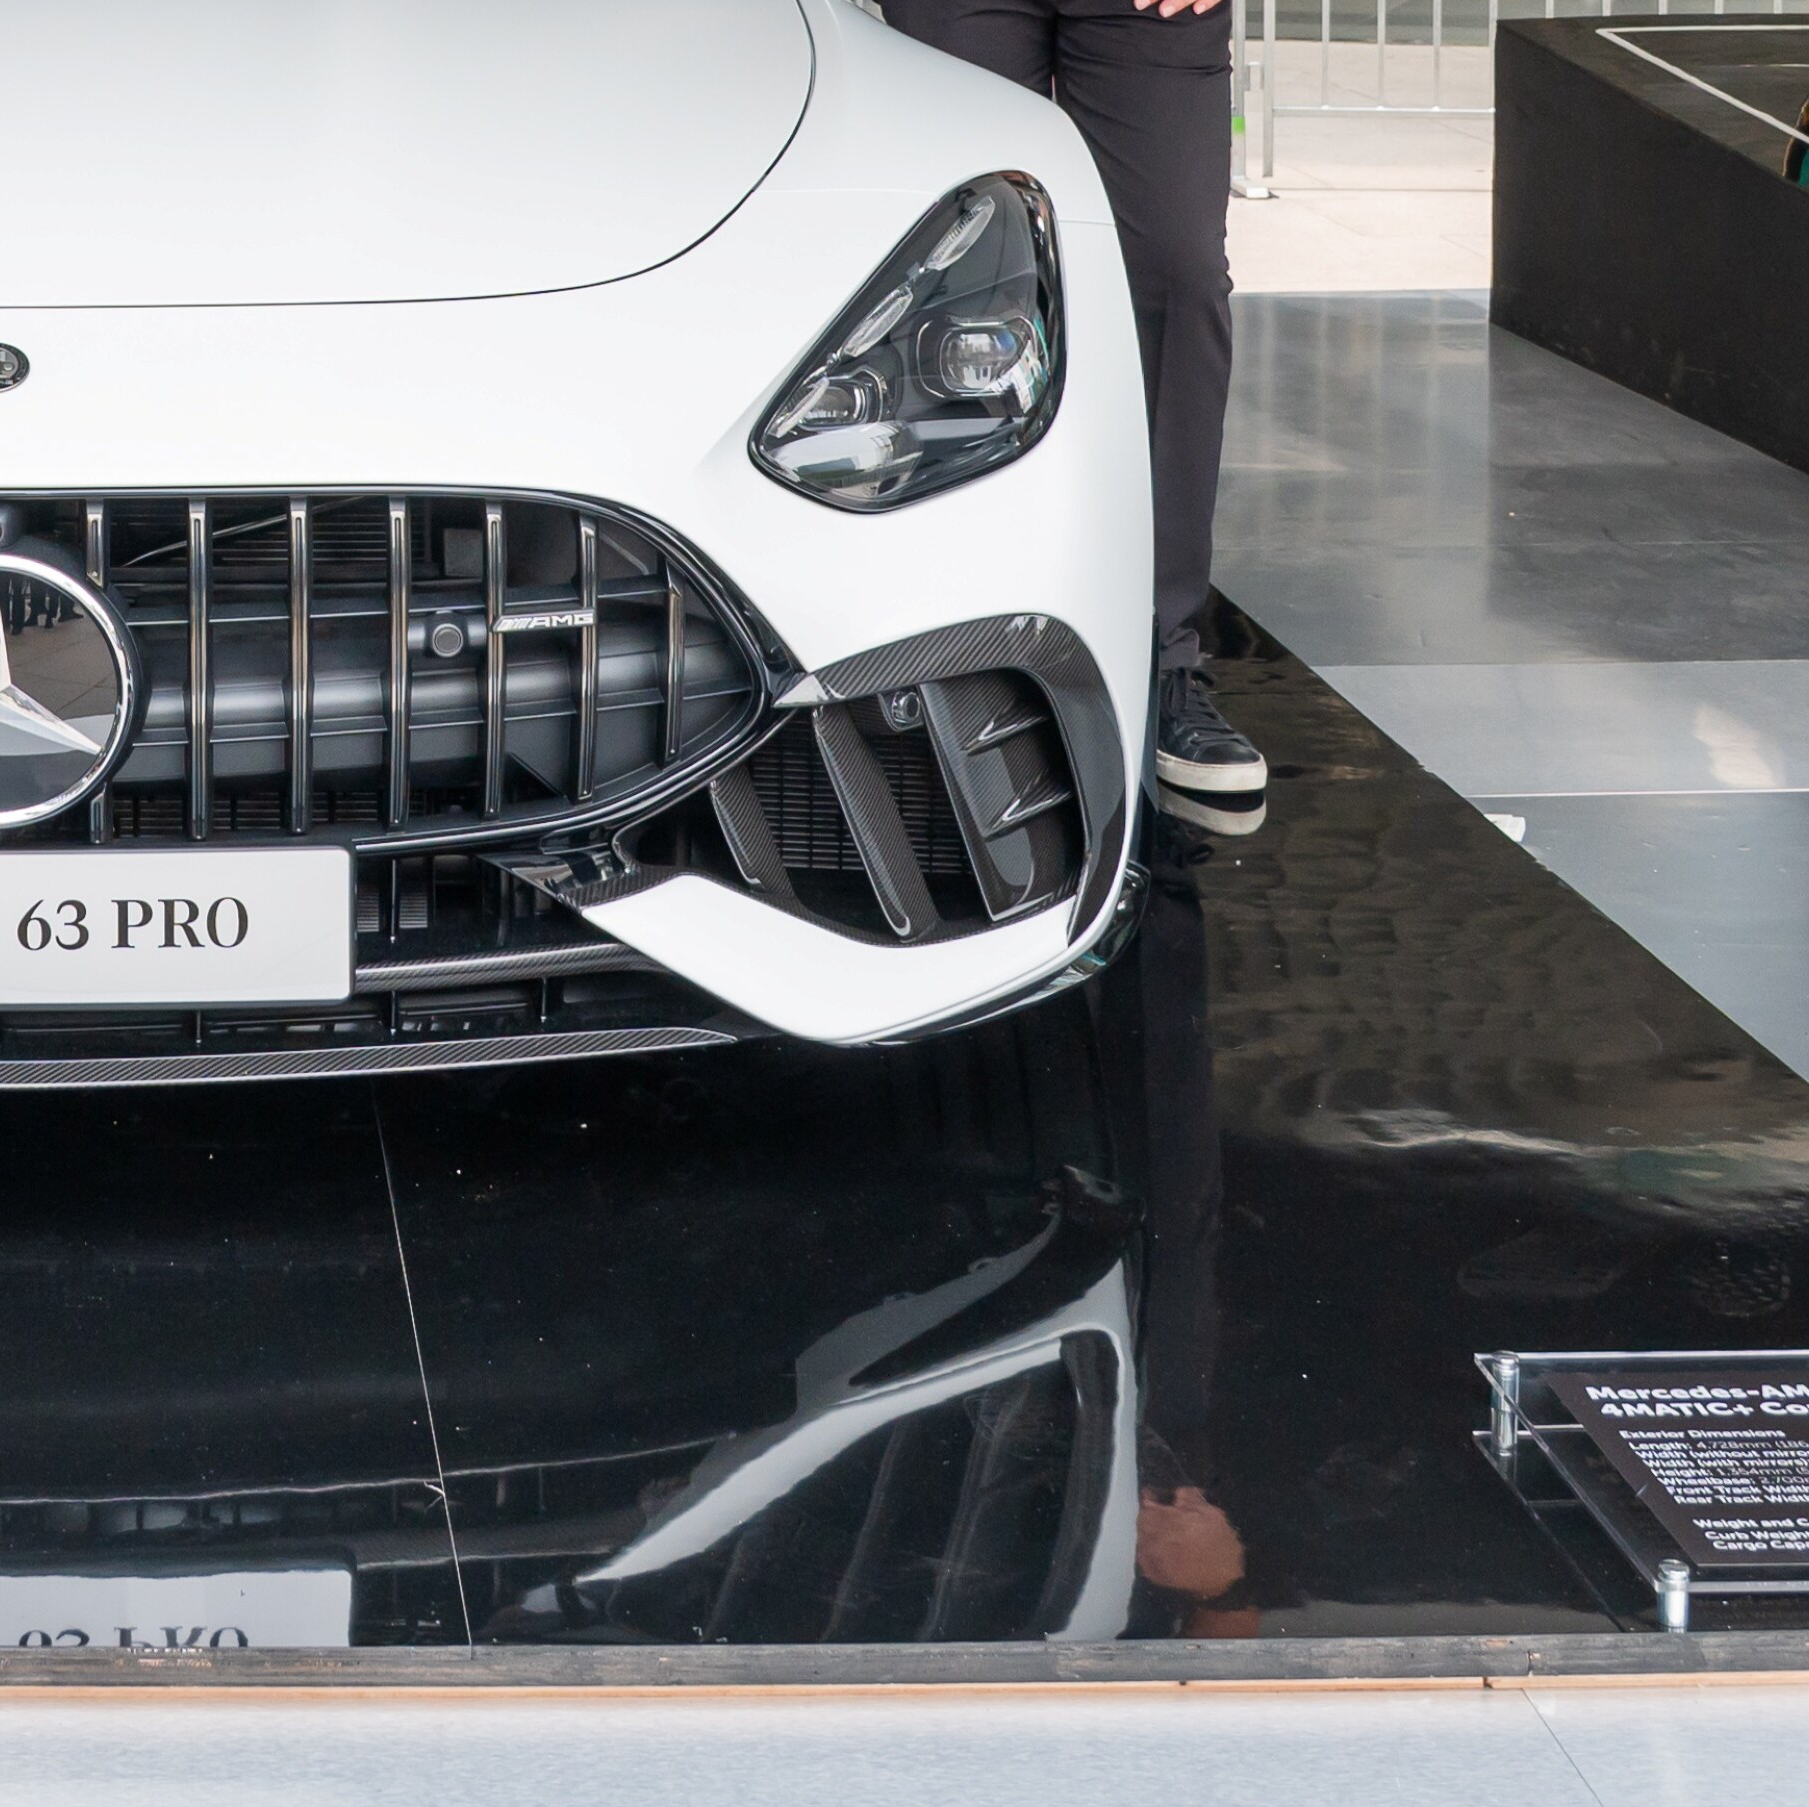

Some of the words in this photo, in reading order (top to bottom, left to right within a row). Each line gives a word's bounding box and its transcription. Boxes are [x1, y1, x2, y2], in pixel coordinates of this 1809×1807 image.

[528, 612, 594, 629] AMG
[16, 899, 90, 950] 63
[111, 897, 250, 948] PRO
[1601, 1402, 1754, 1417] 4MATIC+
[1759, 1401, 1809, 1415] Co
[1618, 1430, 1685, 1439] Exterior
[1687, 1429, 1786, 1438] Dimensions
[1635, 1450, 1687, 1459] Width
[1688, 1449, 1760, 1459] (without
[1762, 1449, 1809, 1458] mirro
[1642, 1459, 1695, 1468] Width
[1696, 1458, 1740, 1467] (with
[1665, 1485, 1713, 1495] Front
[1713, 1485, 1762, 1494] Track
[1673, 1495, 1713, 1504] Rear
[1715, 1495, 1764, 1504] Track
[1693, 1518, 1758, 1529] Weight
[1760, 1518, 1795, 1528] and
[1704, 1530, 1750, 1540] Curb
[1712, 1540, 1768, 1551] Cargo
